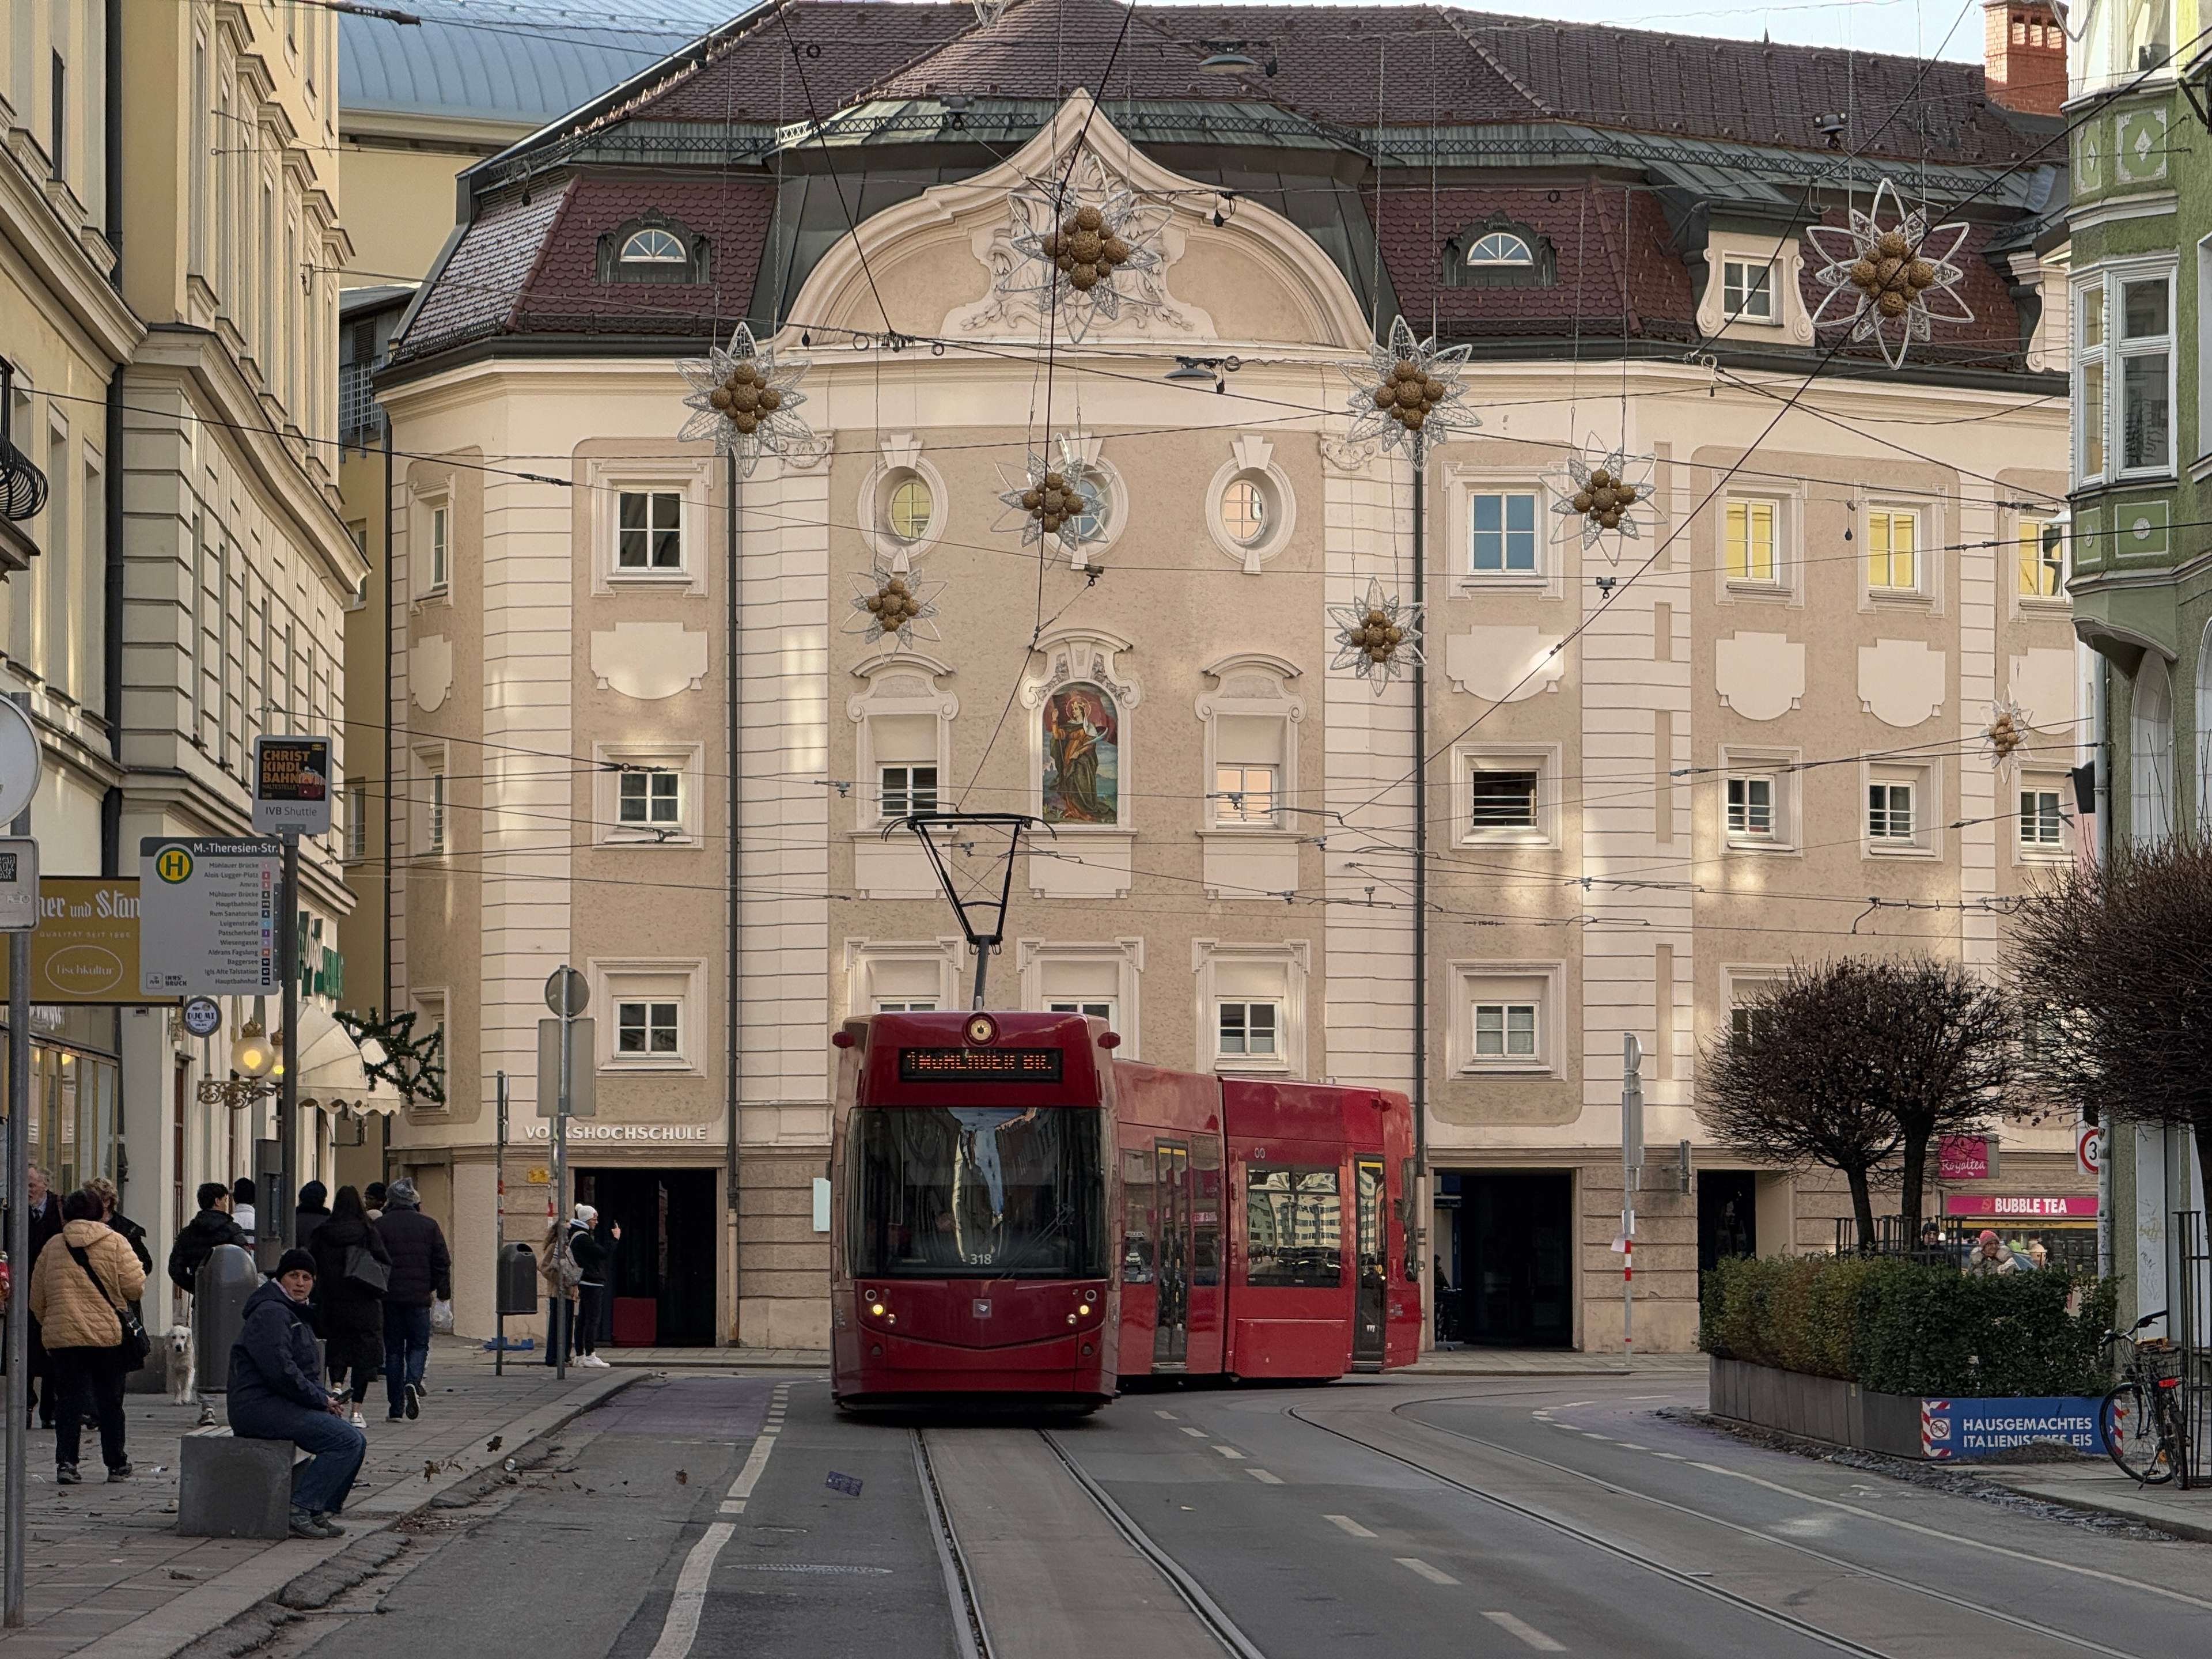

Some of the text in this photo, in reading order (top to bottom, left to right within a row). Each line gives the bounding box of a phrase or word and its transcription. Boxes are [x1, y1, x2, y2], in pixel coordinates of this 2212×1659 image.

[263, 750, 310, 762] CHRIST
[263, 761, 300, 772] KINDL
[263, 772, 299, 783] BAHN
[266, 806, 317, 816] IVB Shuttle
[194, 843, 278, 853] M.-Theresien-Str.
[525, 1125, 707, 1140] VOKSHOCHSCHULE
[1941, 1158, 1987, 1174] Royaltea
[1994, 1198, 2067, 1214] BUBBLE TEA
[970, 1253, 991, 1265] 318
[1963, 1418, 2092, 1431] HAUSGEMACHTES
[2071, 1434, 2093, 1447] EIS
